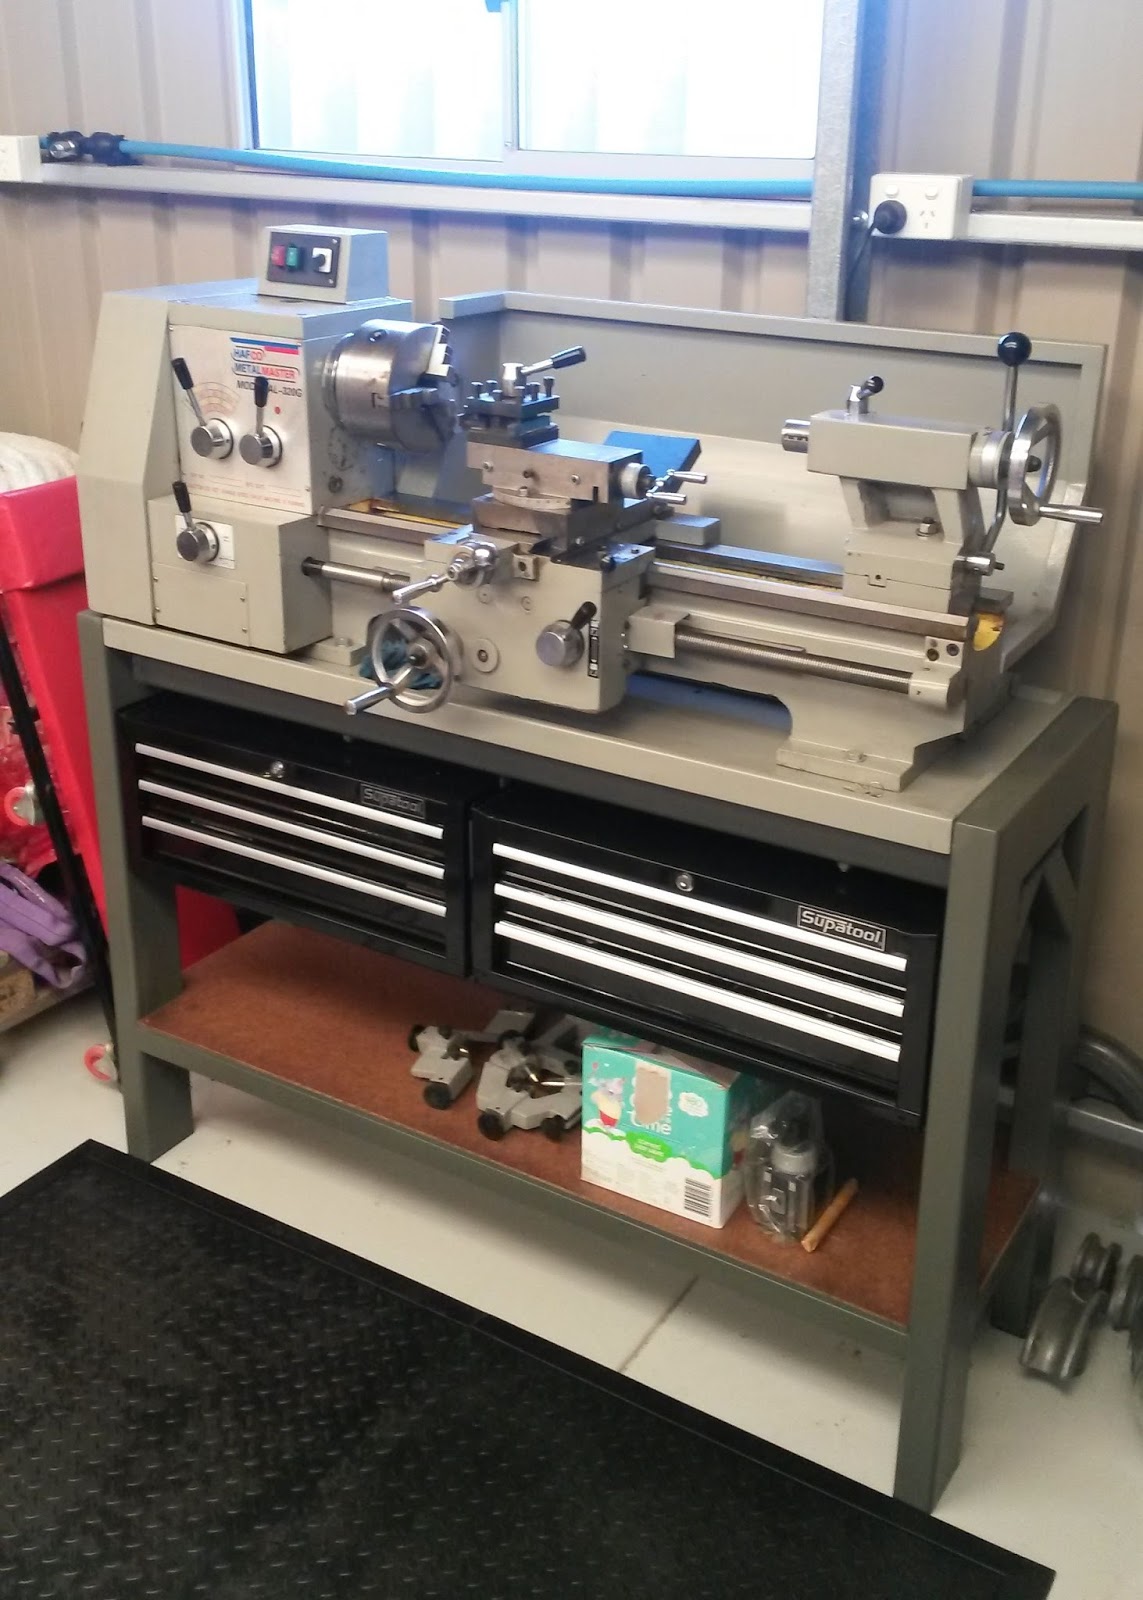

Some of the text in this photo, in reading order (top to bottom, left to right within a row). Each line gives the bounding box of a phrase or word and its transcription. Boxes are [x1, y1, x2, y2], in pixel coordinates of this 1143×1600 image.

[233, 349, 263, 361] HAFCO
[234, 363, 296, 379] METALMASTER
[801, 910, 881, 943] Supatool
